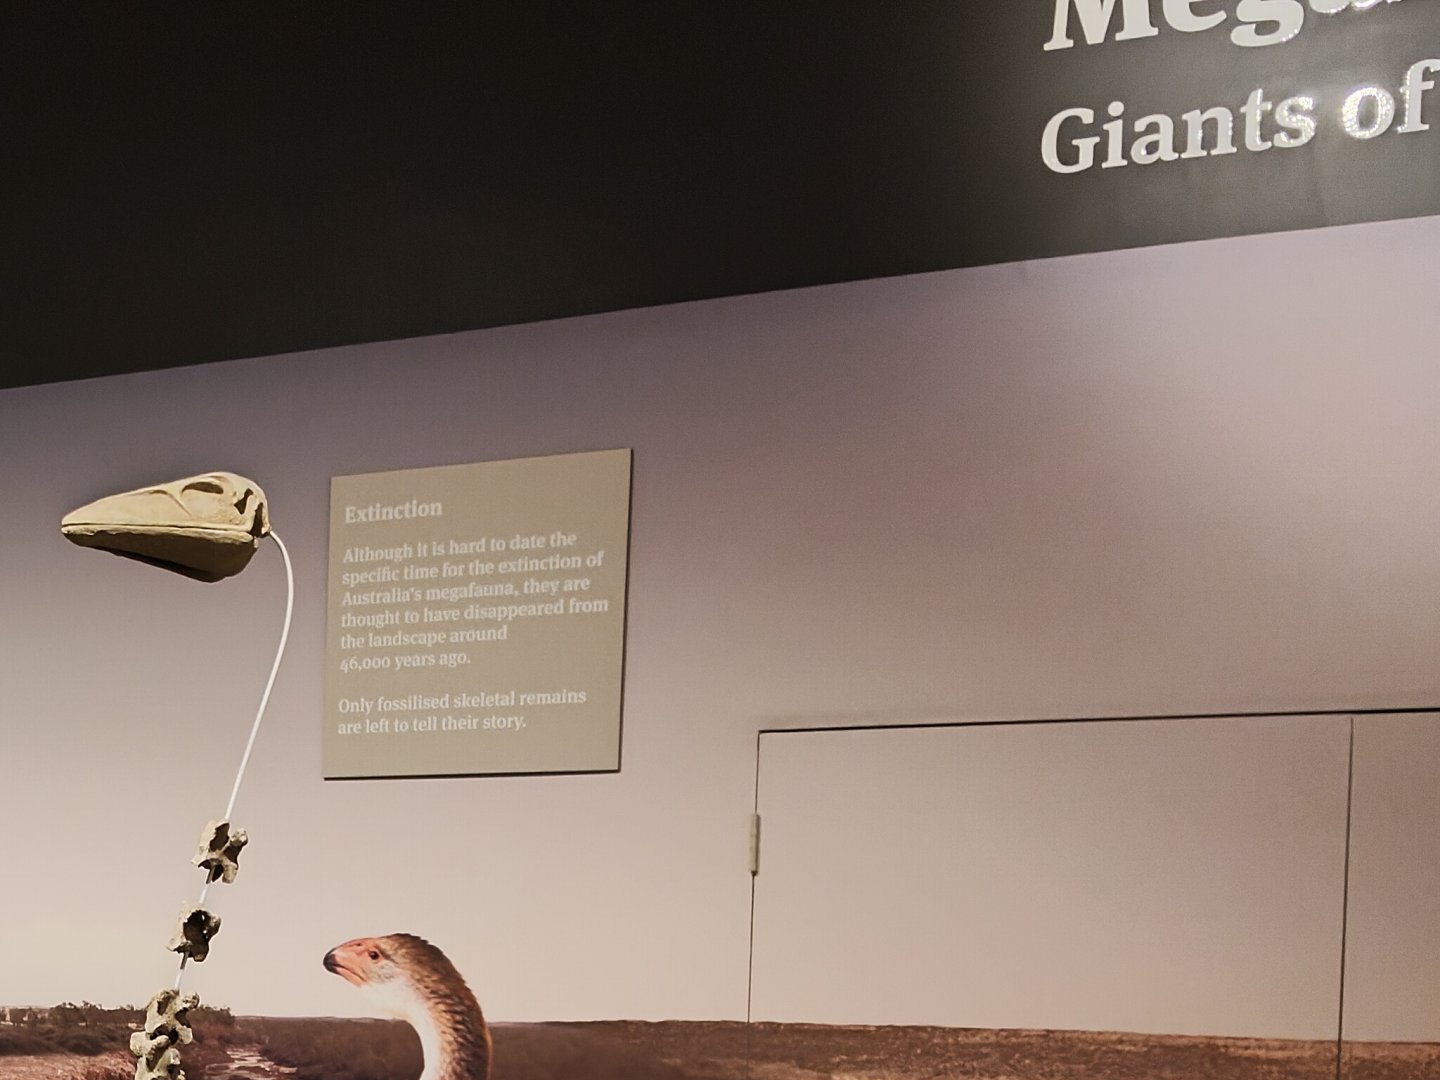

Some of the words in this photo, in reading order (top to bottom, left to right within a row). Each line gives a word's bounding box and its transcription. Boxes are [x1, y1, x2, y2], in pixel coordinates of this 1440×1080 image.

[1041, 88, 1316, 174] Giants
[1341, 58, 1440, 140] of
[345, 499, 442, 523] Extinction
[343, 544, 413, 563] Although
[417, 542, 427, 557] it
[432, 541, 445, 556] is
[449, 537, 486, 555] hard
[490, 538, 506, 551] to
[509, 534, 546, 550] date
[550, 531, 577, 547] the
[342, 567, 400, 586] specific
[404, 565, 439, 580] time
[442, 562, 465, 578] for
[468, 560, 495, 576] the
[498, 554, 582, 573] extinction
[586, 551, 604, 567] of
[342, 587, 422, 607] Australia's
[426, 583, 519, 601] megafauna,
[524, 578, 560, 594] they
[563, 578, 590, 591] are
[341, 610, 400, 628] thought
[404, 610, 420, 624] to
[423, 608, 460, 622] have
[463, 599, 564, 621] disappeared
[569, 598, 608, 613] from
[341, 635, 365, 649] the
[368, 631, 446, 648] landscape
[449, 625, 507, 642] around
[339, 656, 391, 673] 46,000
[395, 654, 436, 671] years
[439, 653, 471, 668] ago.
[338, 698, 374, 714] Only
[377, 693, 449, 712] fossilised
[454, 690, 515, 708] skeletal
[520, 689, 587, 705] remains
[338, 723, 362, 734] are
[365, 718, 389, 733] left
[394, 718, 409, 732] to
[413, 716, 437, 731] tell
[442, 715, 479, 731] their
[483, 715, 526, 731] story.
